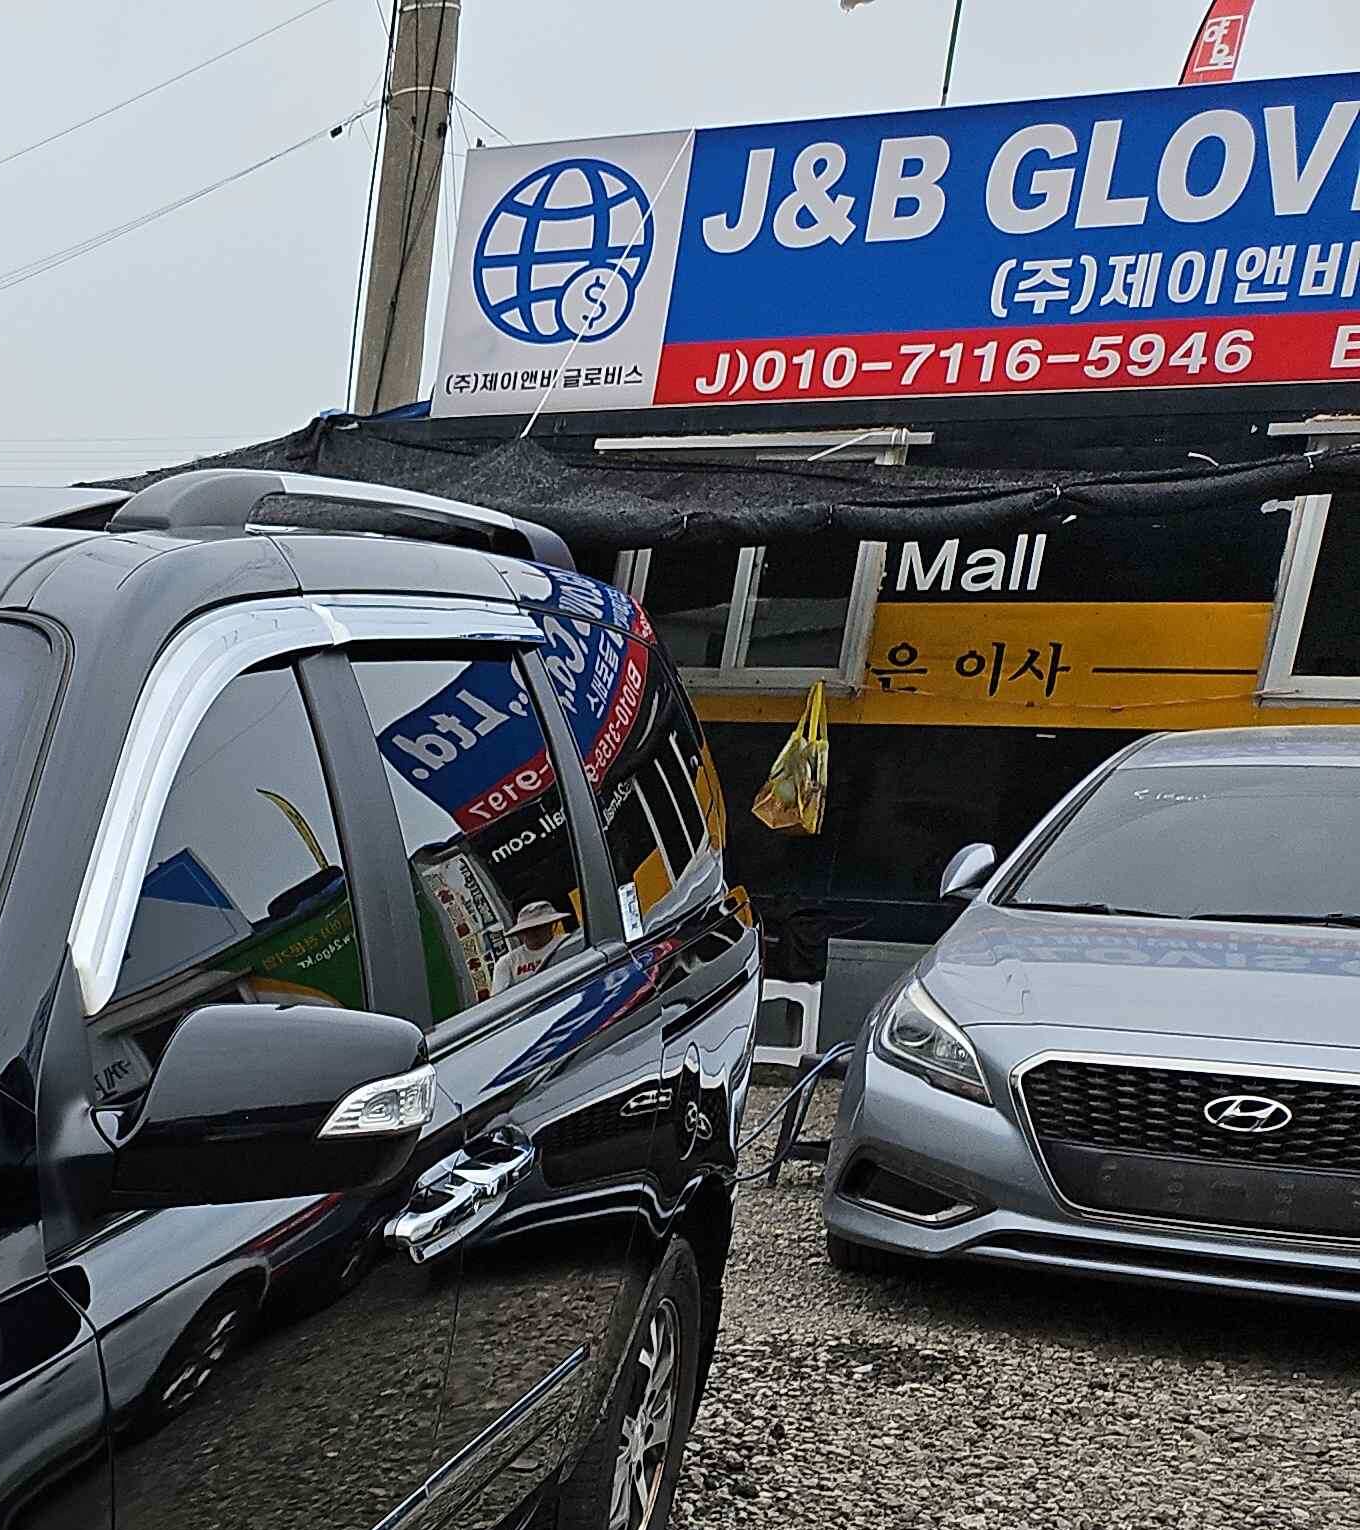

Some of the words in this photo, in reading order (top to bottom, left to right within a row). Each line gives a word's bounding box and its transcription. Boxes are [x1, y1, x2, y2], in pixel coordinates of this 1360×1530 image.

[702, 136, 949, 255] J&B
[985, 100, 1360, 235] GLOV
[990, 240, 1360, 318] (주)제이앤비
[694, 329, 1255, 396] J)010-7116-5946
[954, 641, 1072, 698] 이사
